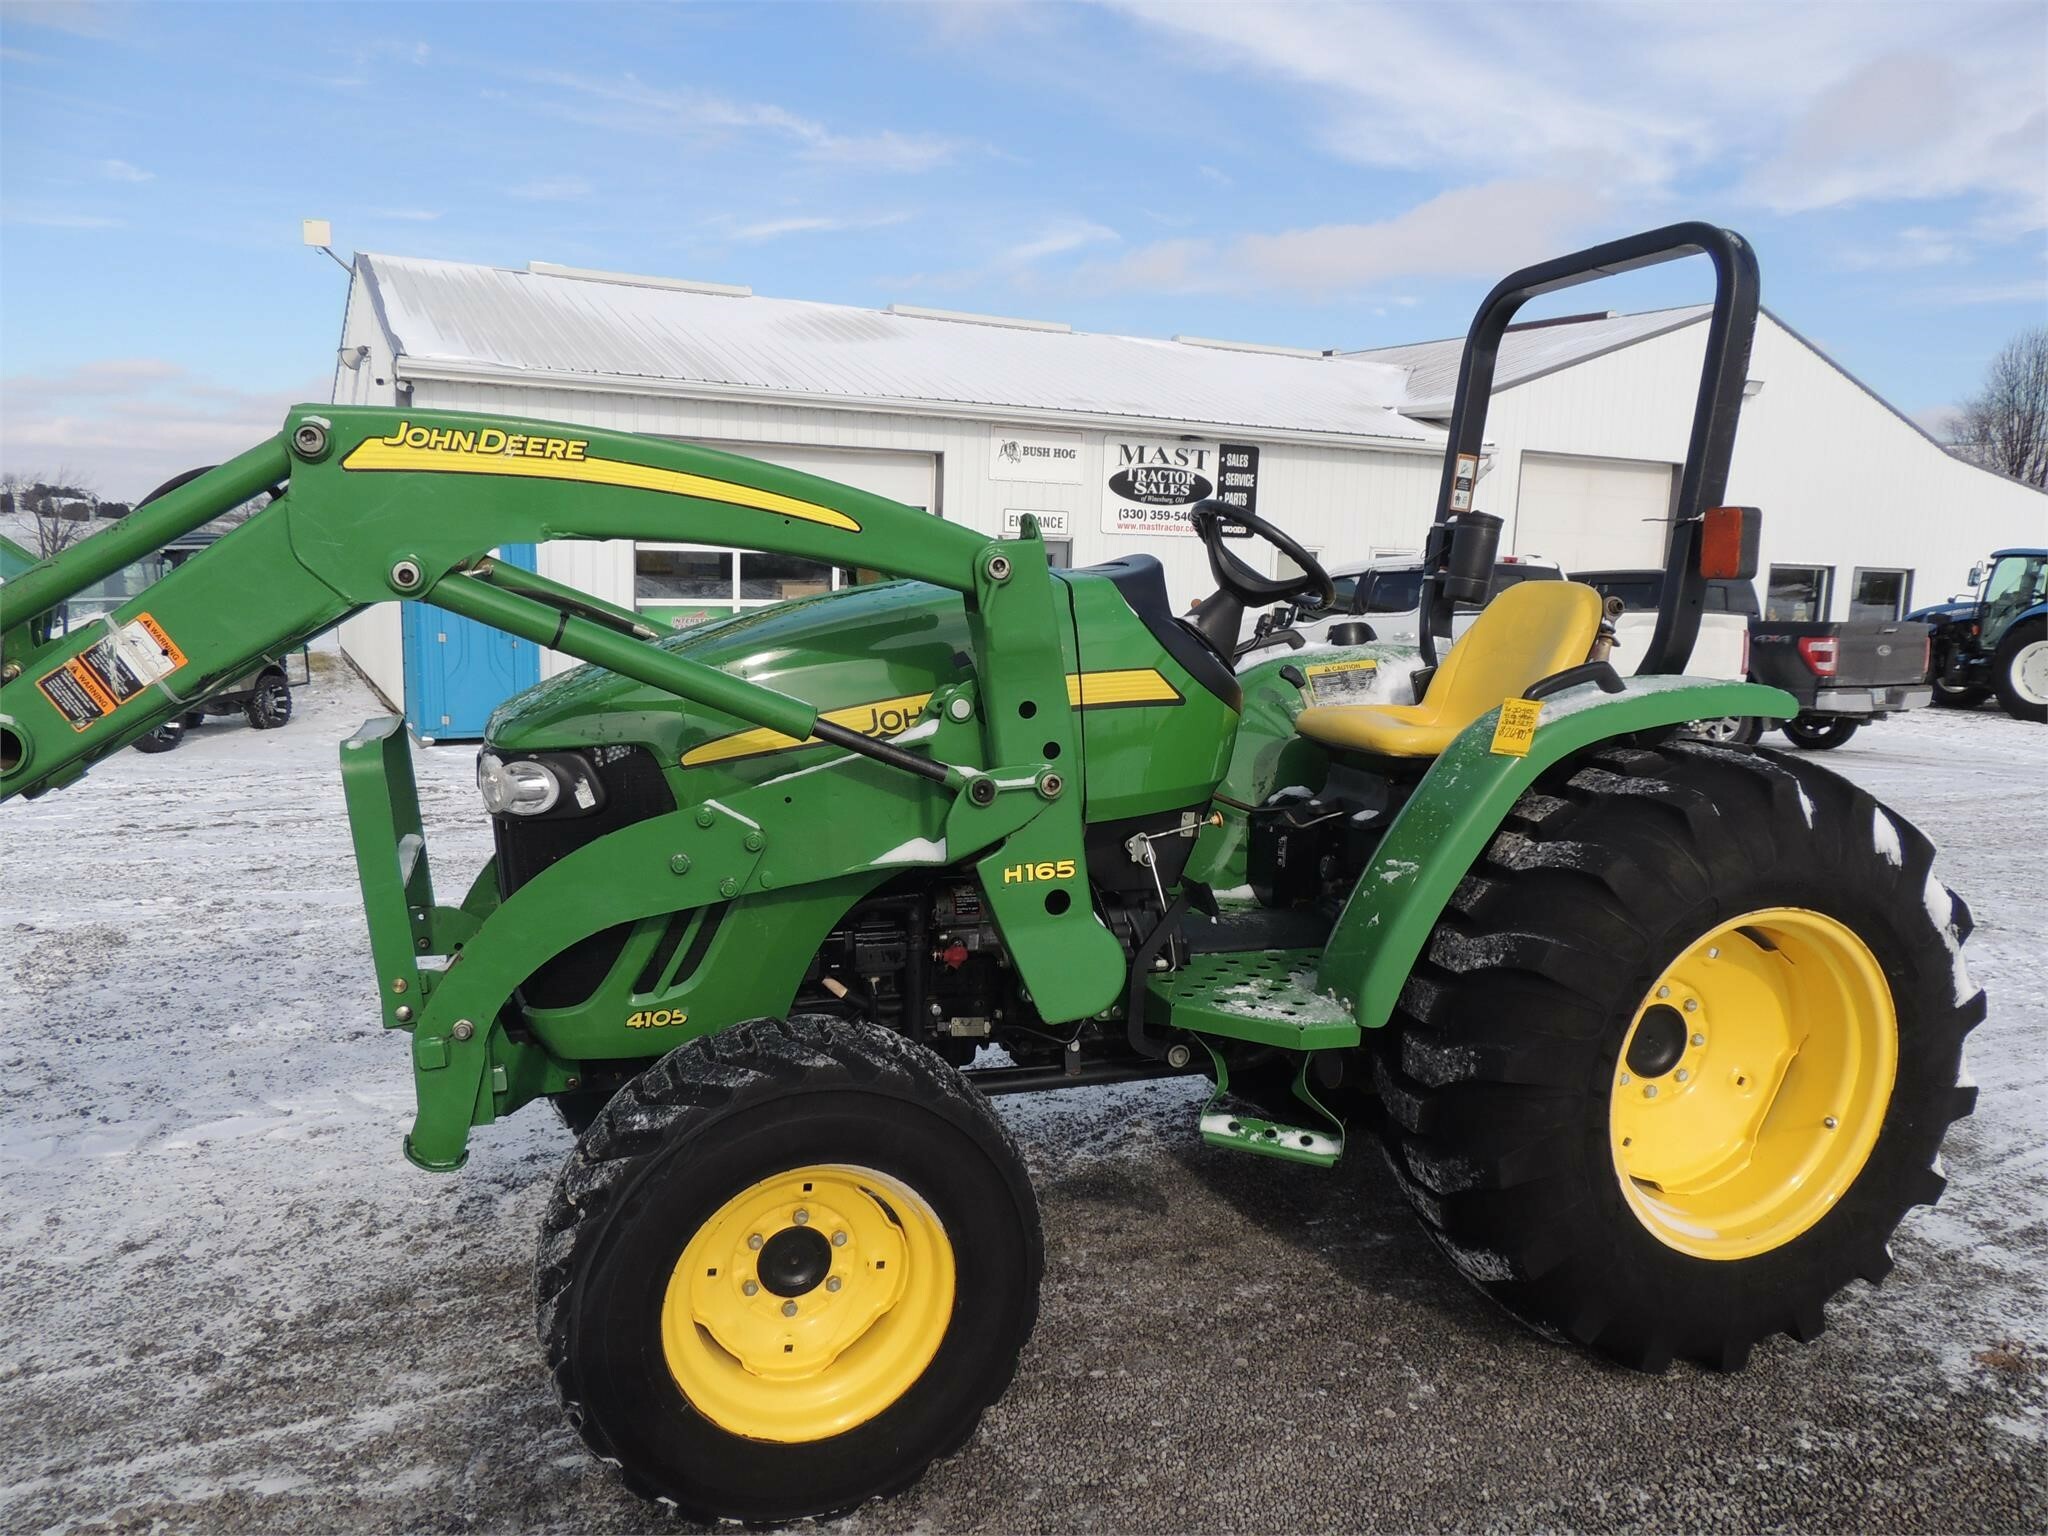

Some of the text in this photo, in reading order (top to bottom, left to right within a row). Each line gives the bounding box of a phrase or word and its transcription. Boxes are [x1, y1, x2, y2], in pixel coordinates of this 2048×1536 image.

[383, 421, 588, 461] JOHN DEERE
[1023, 446, 1076, 459] BUSH HOG
[1117, 443, 1210, 471] MAST
[1226, 453, 1249, 468] SALES
[1125, 467, 1196, 485] TRACTOR
[1225, 472, 1255, 487] SERVICE
[1134, 481, 1190, 496] SALES
[1224, 492, 1247, 506] PARTS
[1009, 515, 1063, 528] ENANCE
[1119, 509, 1147, 522] (330)
[1117, 522, 1197, 533] www.masttractor.co
[150, 626, 180, 662] WARNING
[1331, 663, 1361, 672] CAUTION
[78, 674, 109, 709] WARNING
[862, 706, 923, 734] JOH
[1004, 859, 1076, 884] H165
[625, 1008, 688, 1029] 4105
